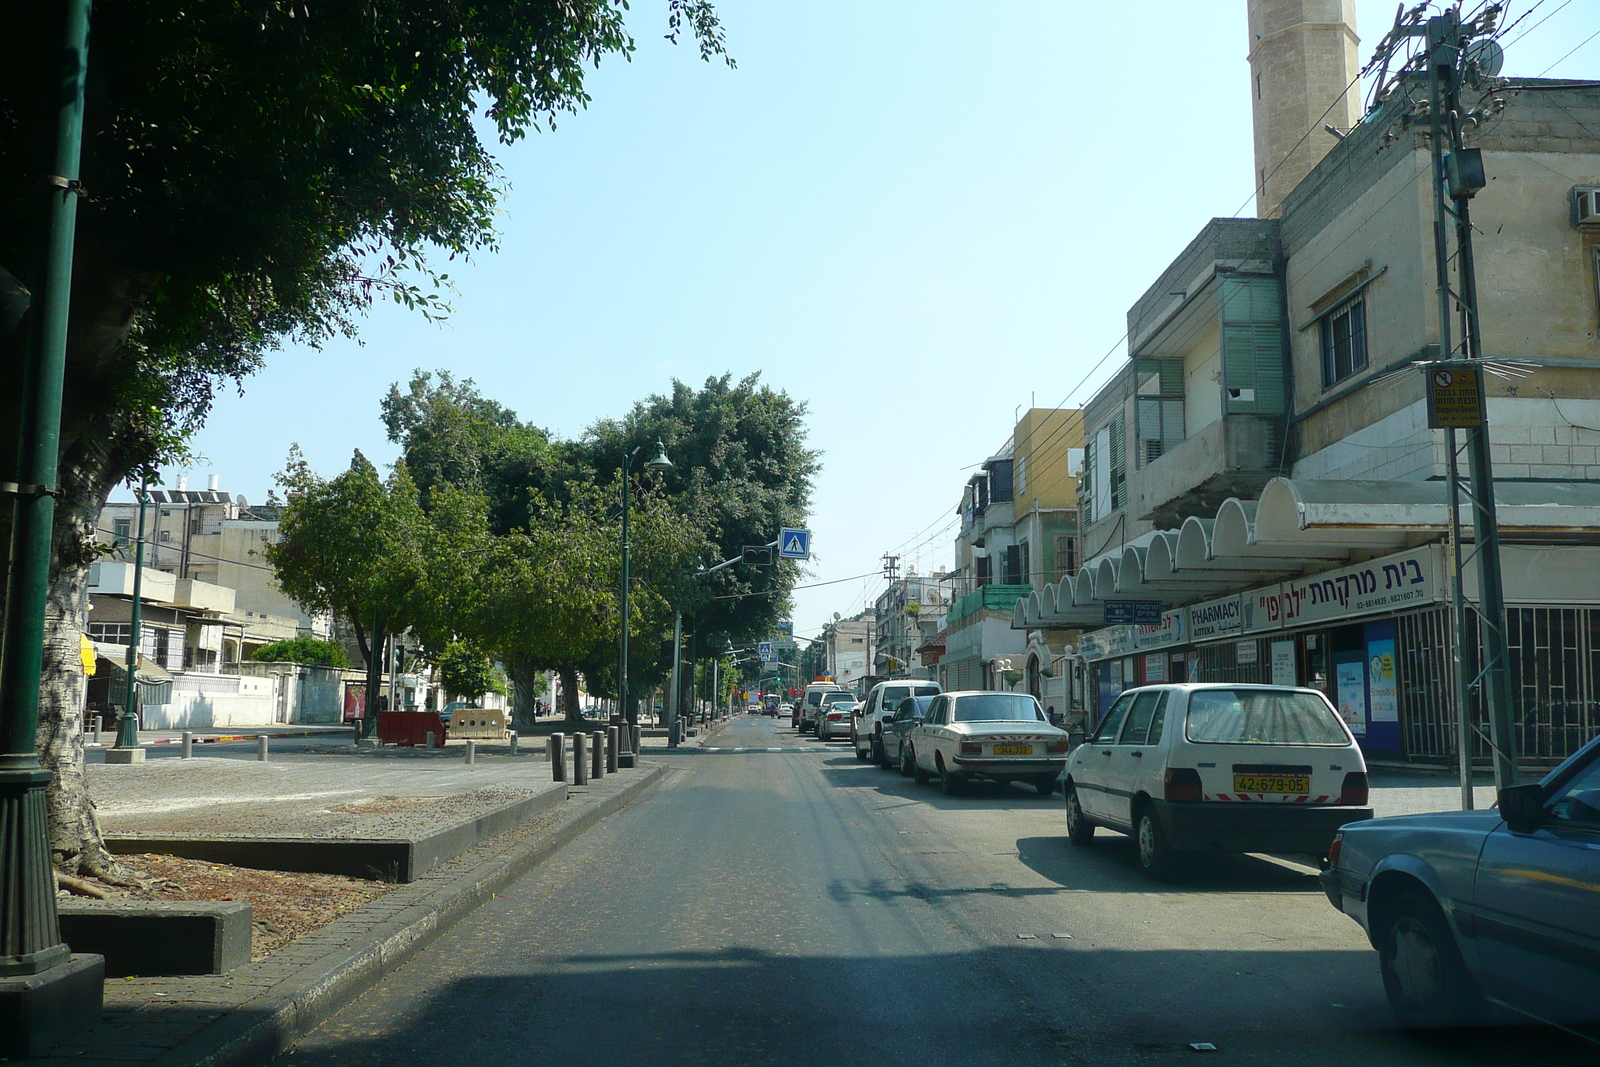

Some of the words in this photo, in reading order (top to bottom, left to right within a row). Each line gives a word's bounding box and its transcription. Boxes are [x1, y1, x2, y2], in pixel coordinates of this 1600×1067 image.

[1436, 406, 1454, 414] Danger
[1382, 559, 1425, 589] בית
[1309, 569, 1377, 609] מרקחת
[1357, 597, 1387, 609] 03-6814939
[1191, 601, 1240, 625] PHARMACY
[1163, 614, 1171, 630] לב
[1218, 621, 1241, 634] صيدلية
[1194, 626, 1216, 637] АПТЕКА
[1239, 778, 1304, 792] 42-679-05
